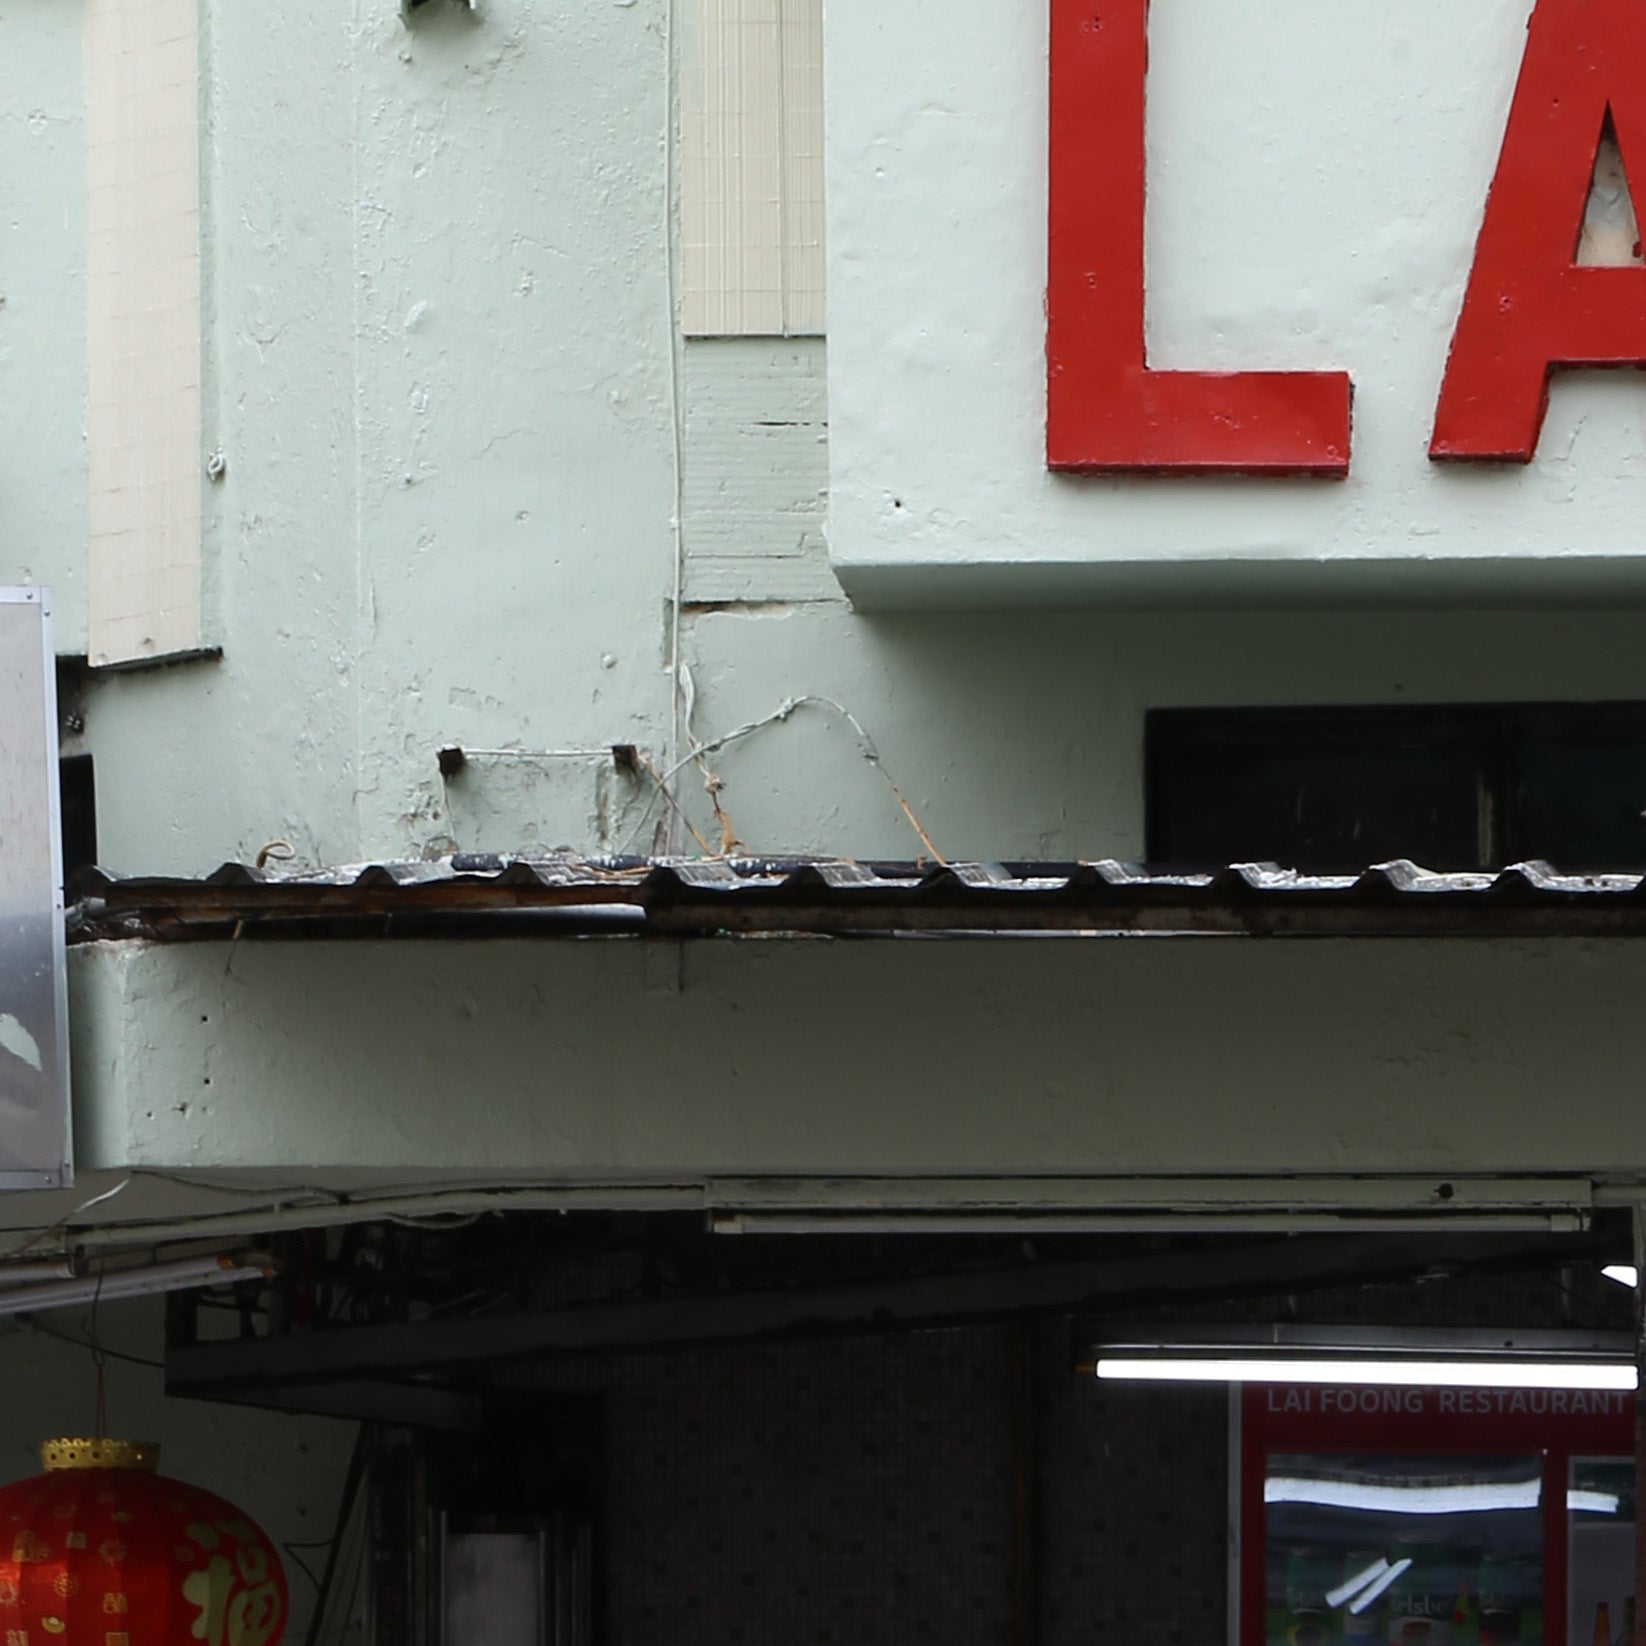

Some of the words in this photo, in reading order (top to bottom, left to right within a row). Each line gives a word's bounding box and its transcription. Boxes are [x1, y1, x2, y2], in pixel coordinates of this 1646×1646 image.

[1267, 1389, 1311, 1413] LAI
[1320, 1389, 1425, 1413] FOONG
[1438, 1388, 1630, 1414] RESTAURANT
